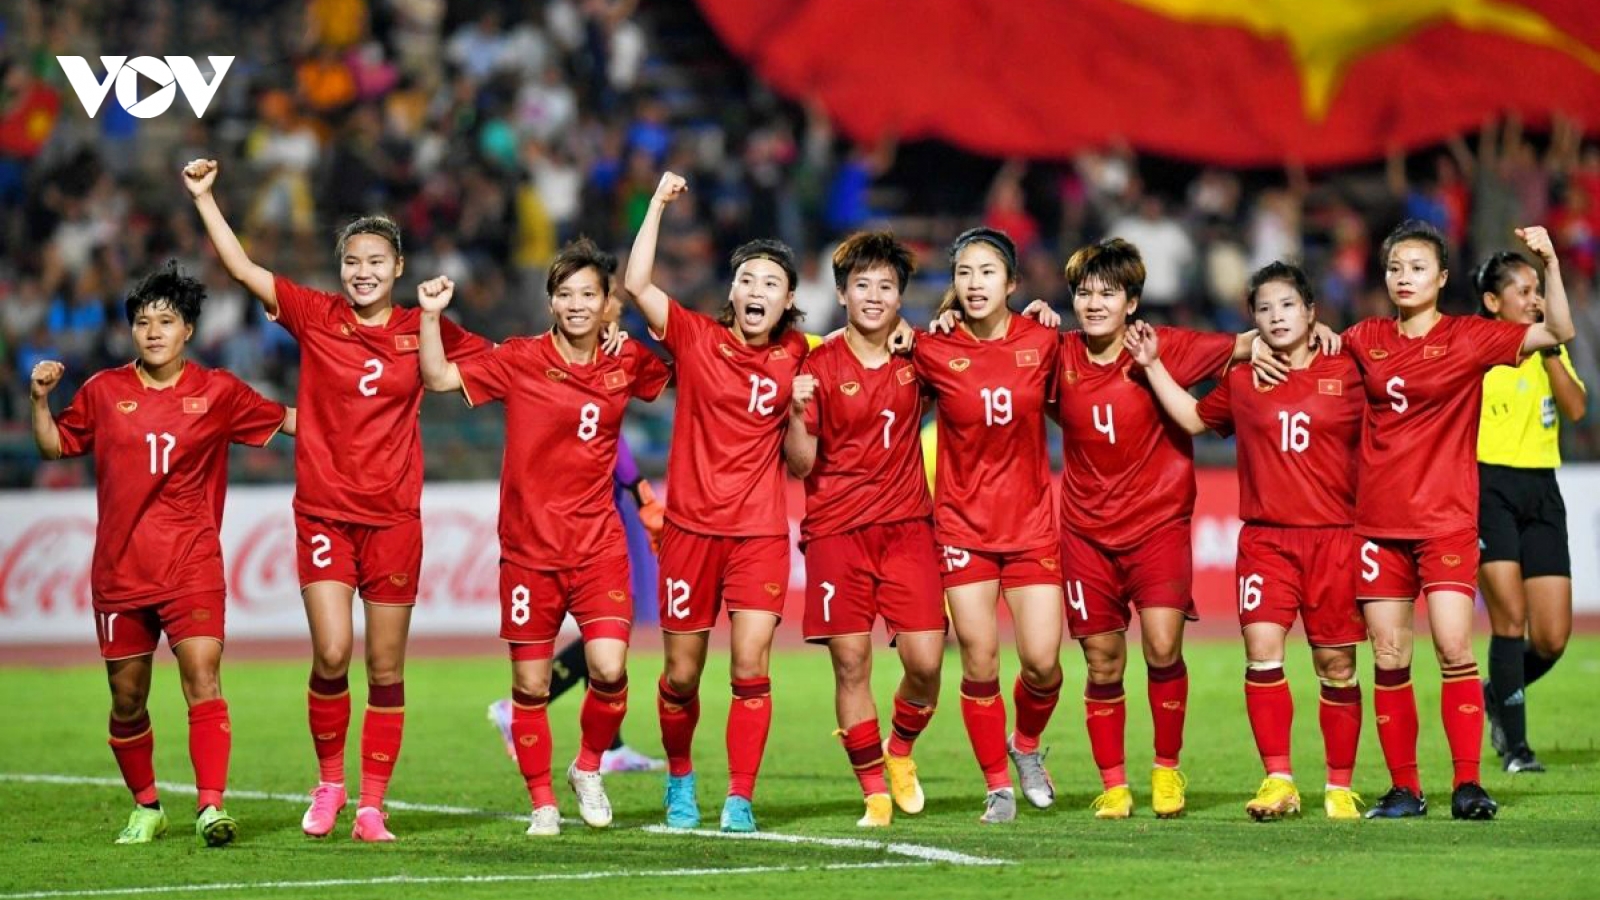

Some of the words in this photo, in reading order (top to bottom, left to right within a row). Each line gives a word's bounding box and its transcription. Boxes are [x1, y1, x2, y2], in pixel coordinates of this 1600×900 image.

[358, 358, 384, 397] 2
[747, 373, 778, 416] 12
[577, 402, 601, 441] 8
[980, 386, 1013, 426] 19
[1092, 403, 1116, 444] 4
[880, 408, 896, 449] 7
[1278, 410, 1311, 453] 16
[145, 432, 176, 475] 17
[311, 533, 332, 568] 2
[511, 584, 530, 627] 8
[666, 577, 691, 620] 12
[820, 581, 836, 622] 7
[1067, 580, 1088, 622] 4
[1239, 573, 1264, 615] 16
